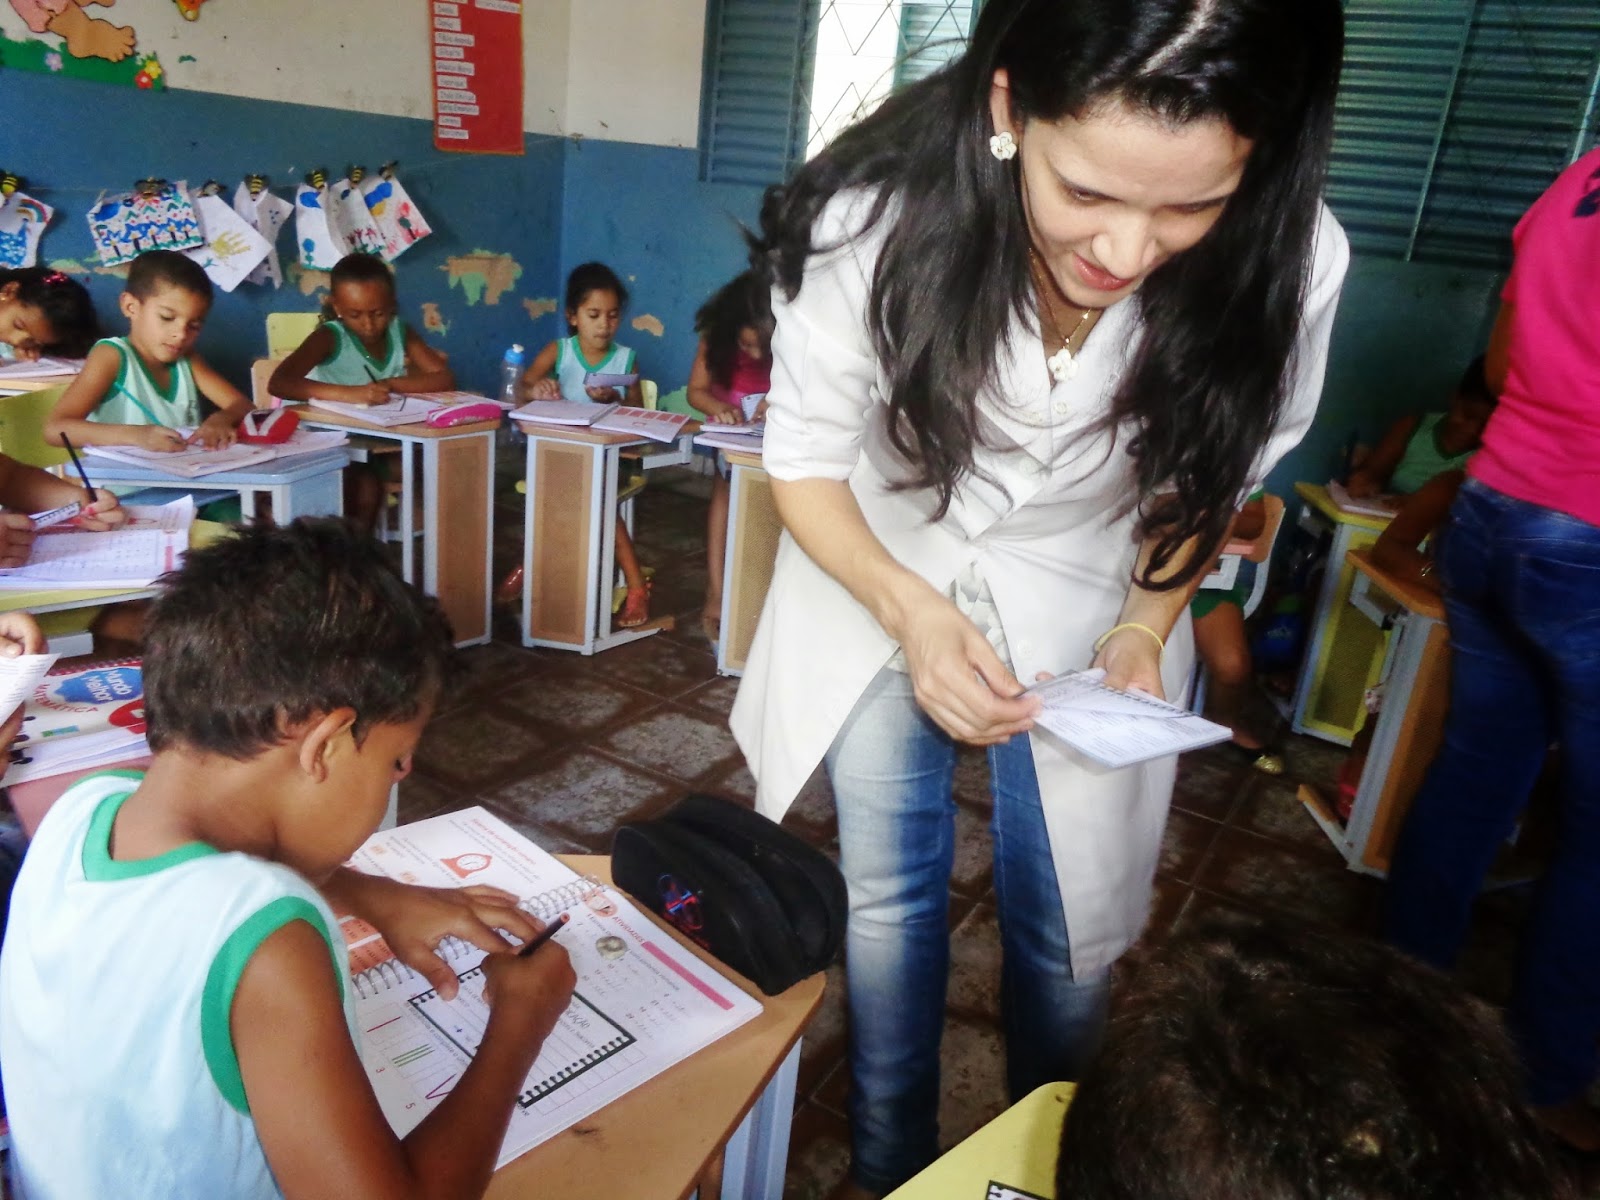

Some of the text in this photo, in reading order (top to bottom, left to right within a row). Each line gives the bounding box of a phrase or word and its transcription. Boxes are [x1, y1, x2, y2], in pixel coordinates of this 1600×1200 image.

[81, 675, 114, 702] Melhor
[103, 669, 133, 695] Mundo
[612, 916, 645, 942] ATIVIDADES
[405, 1102, 416, 1110] 5
